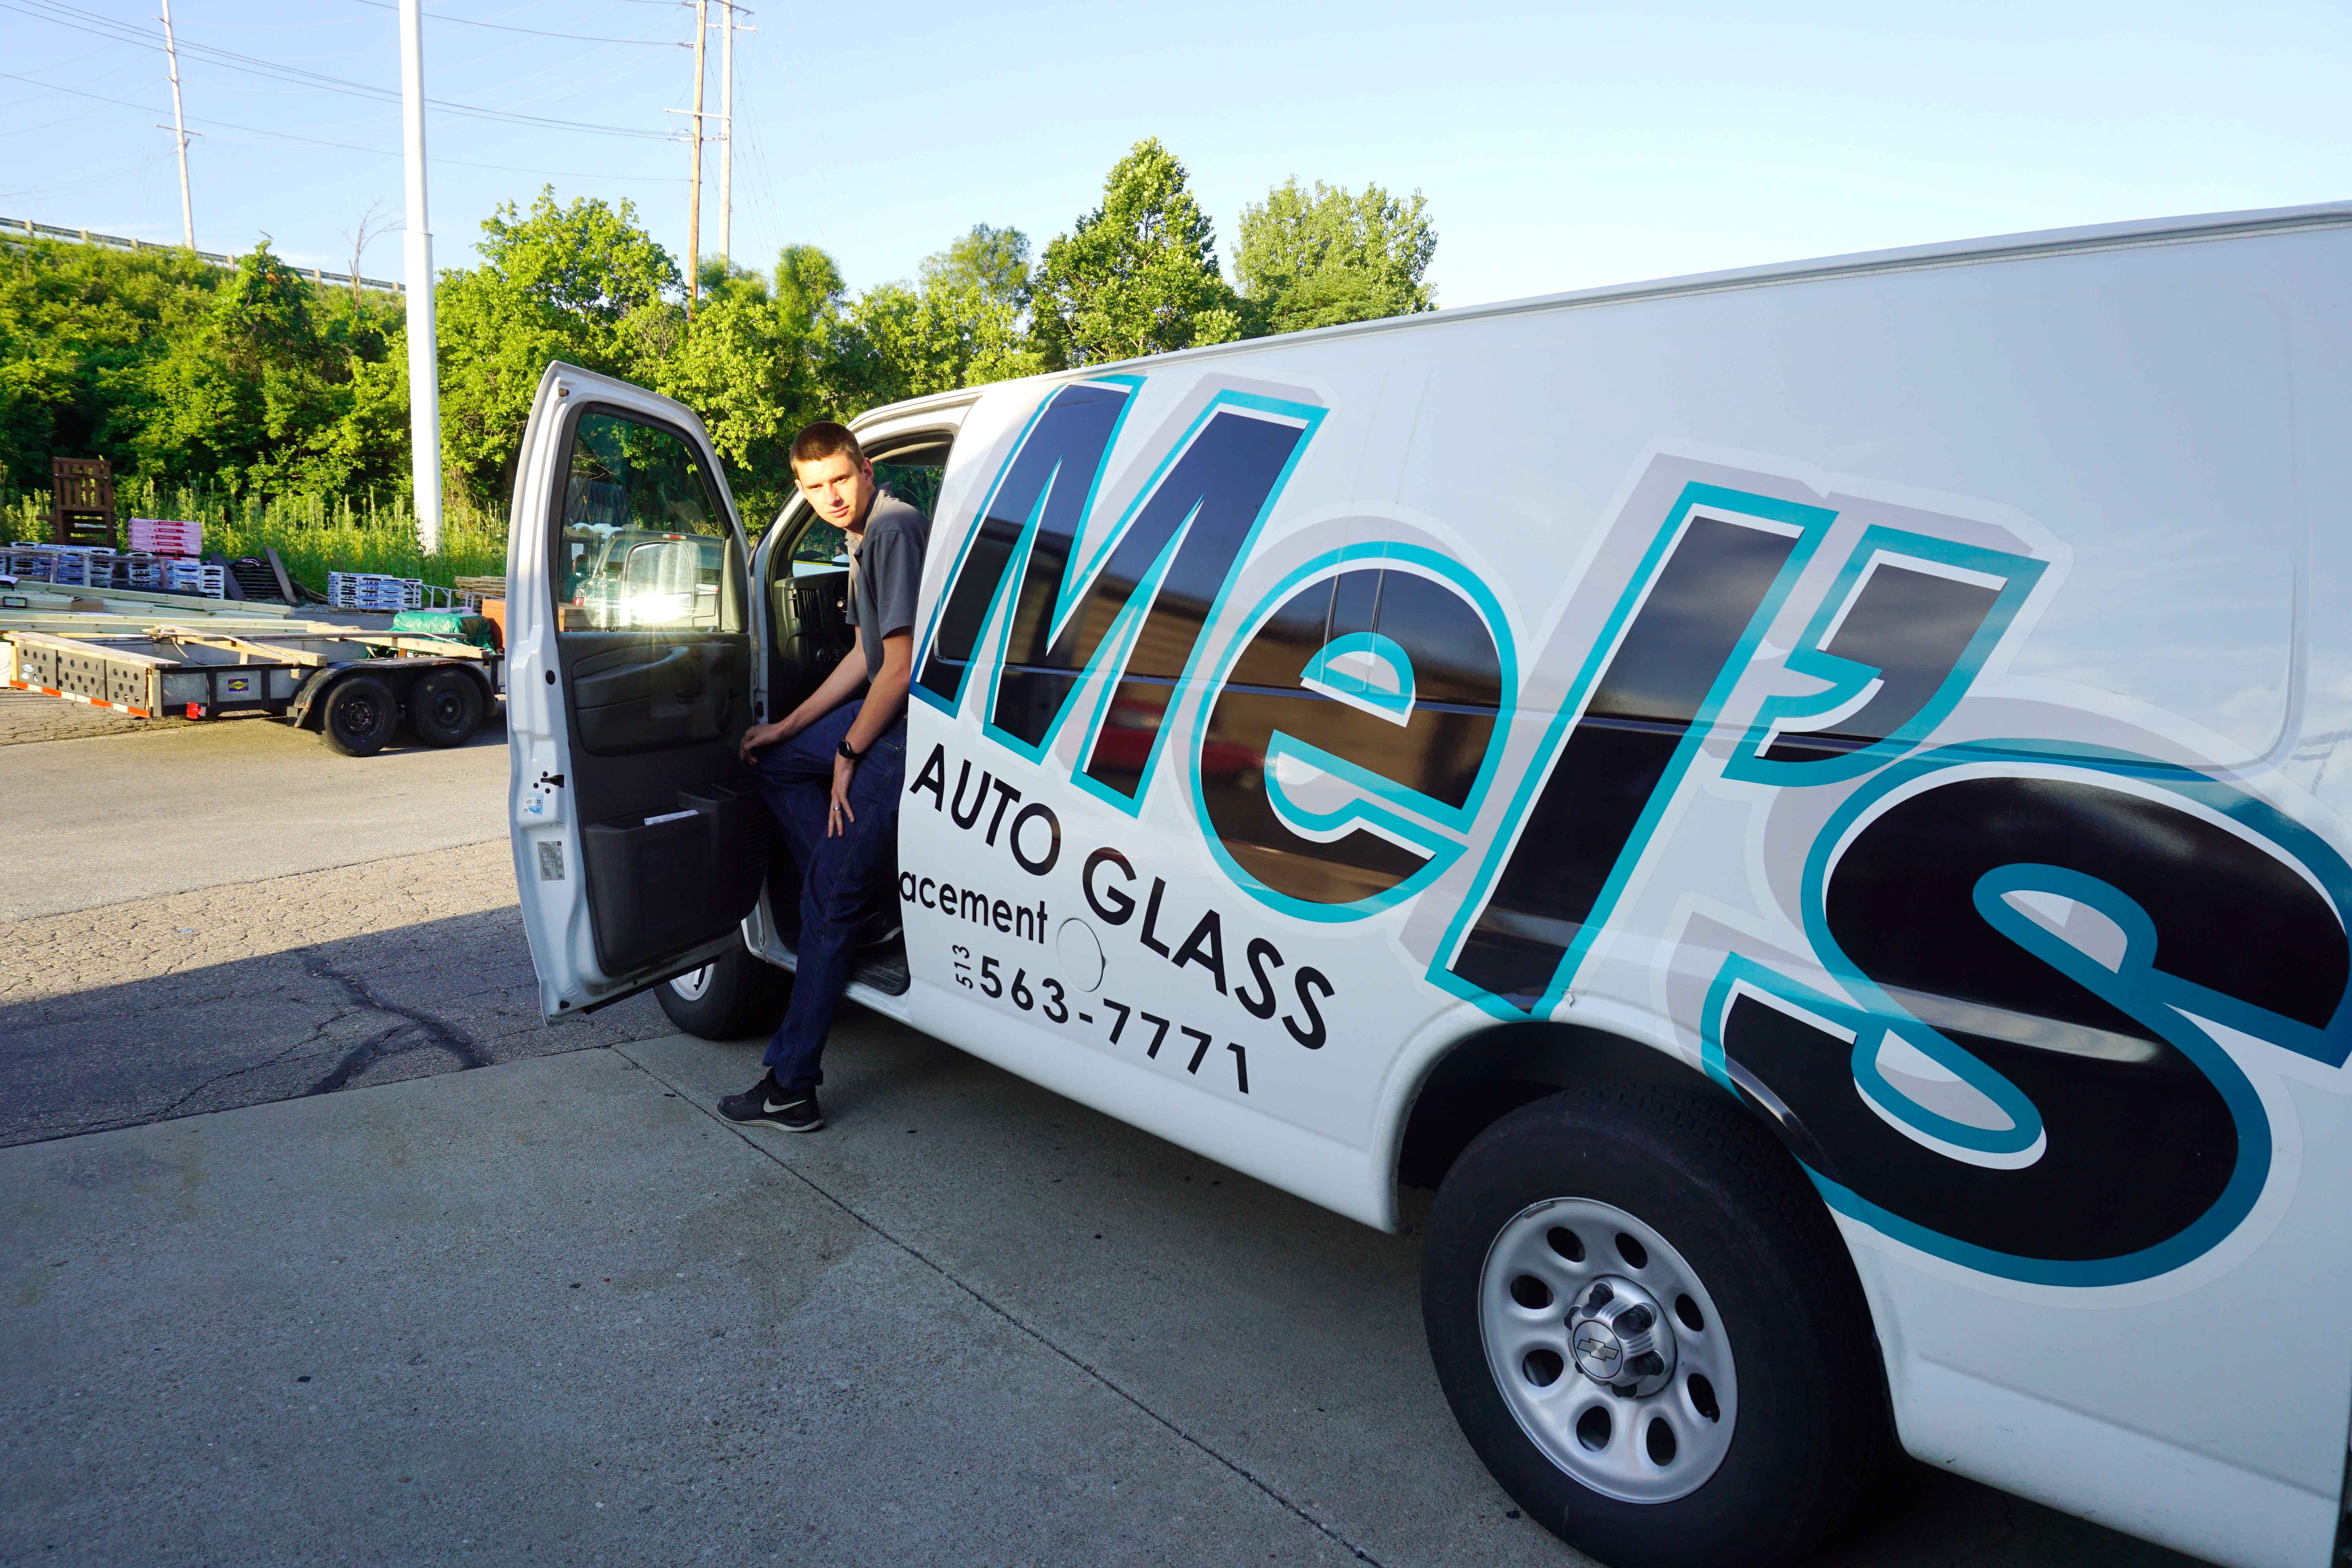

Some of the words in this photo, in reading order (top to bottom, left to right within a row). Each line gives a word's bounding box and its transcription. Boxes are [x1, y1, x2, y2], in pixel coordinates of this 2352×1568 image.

[899, 871, 1048, 944] acement
[909, 743, 1061, 876] AUTO
[1082, 847, 1335, 1050] GLASS
[910, 374, 2352, 1287] Mel's
[952, 944, 974, 989] 513
[980, 955, 1249, 1095] 563-7771
